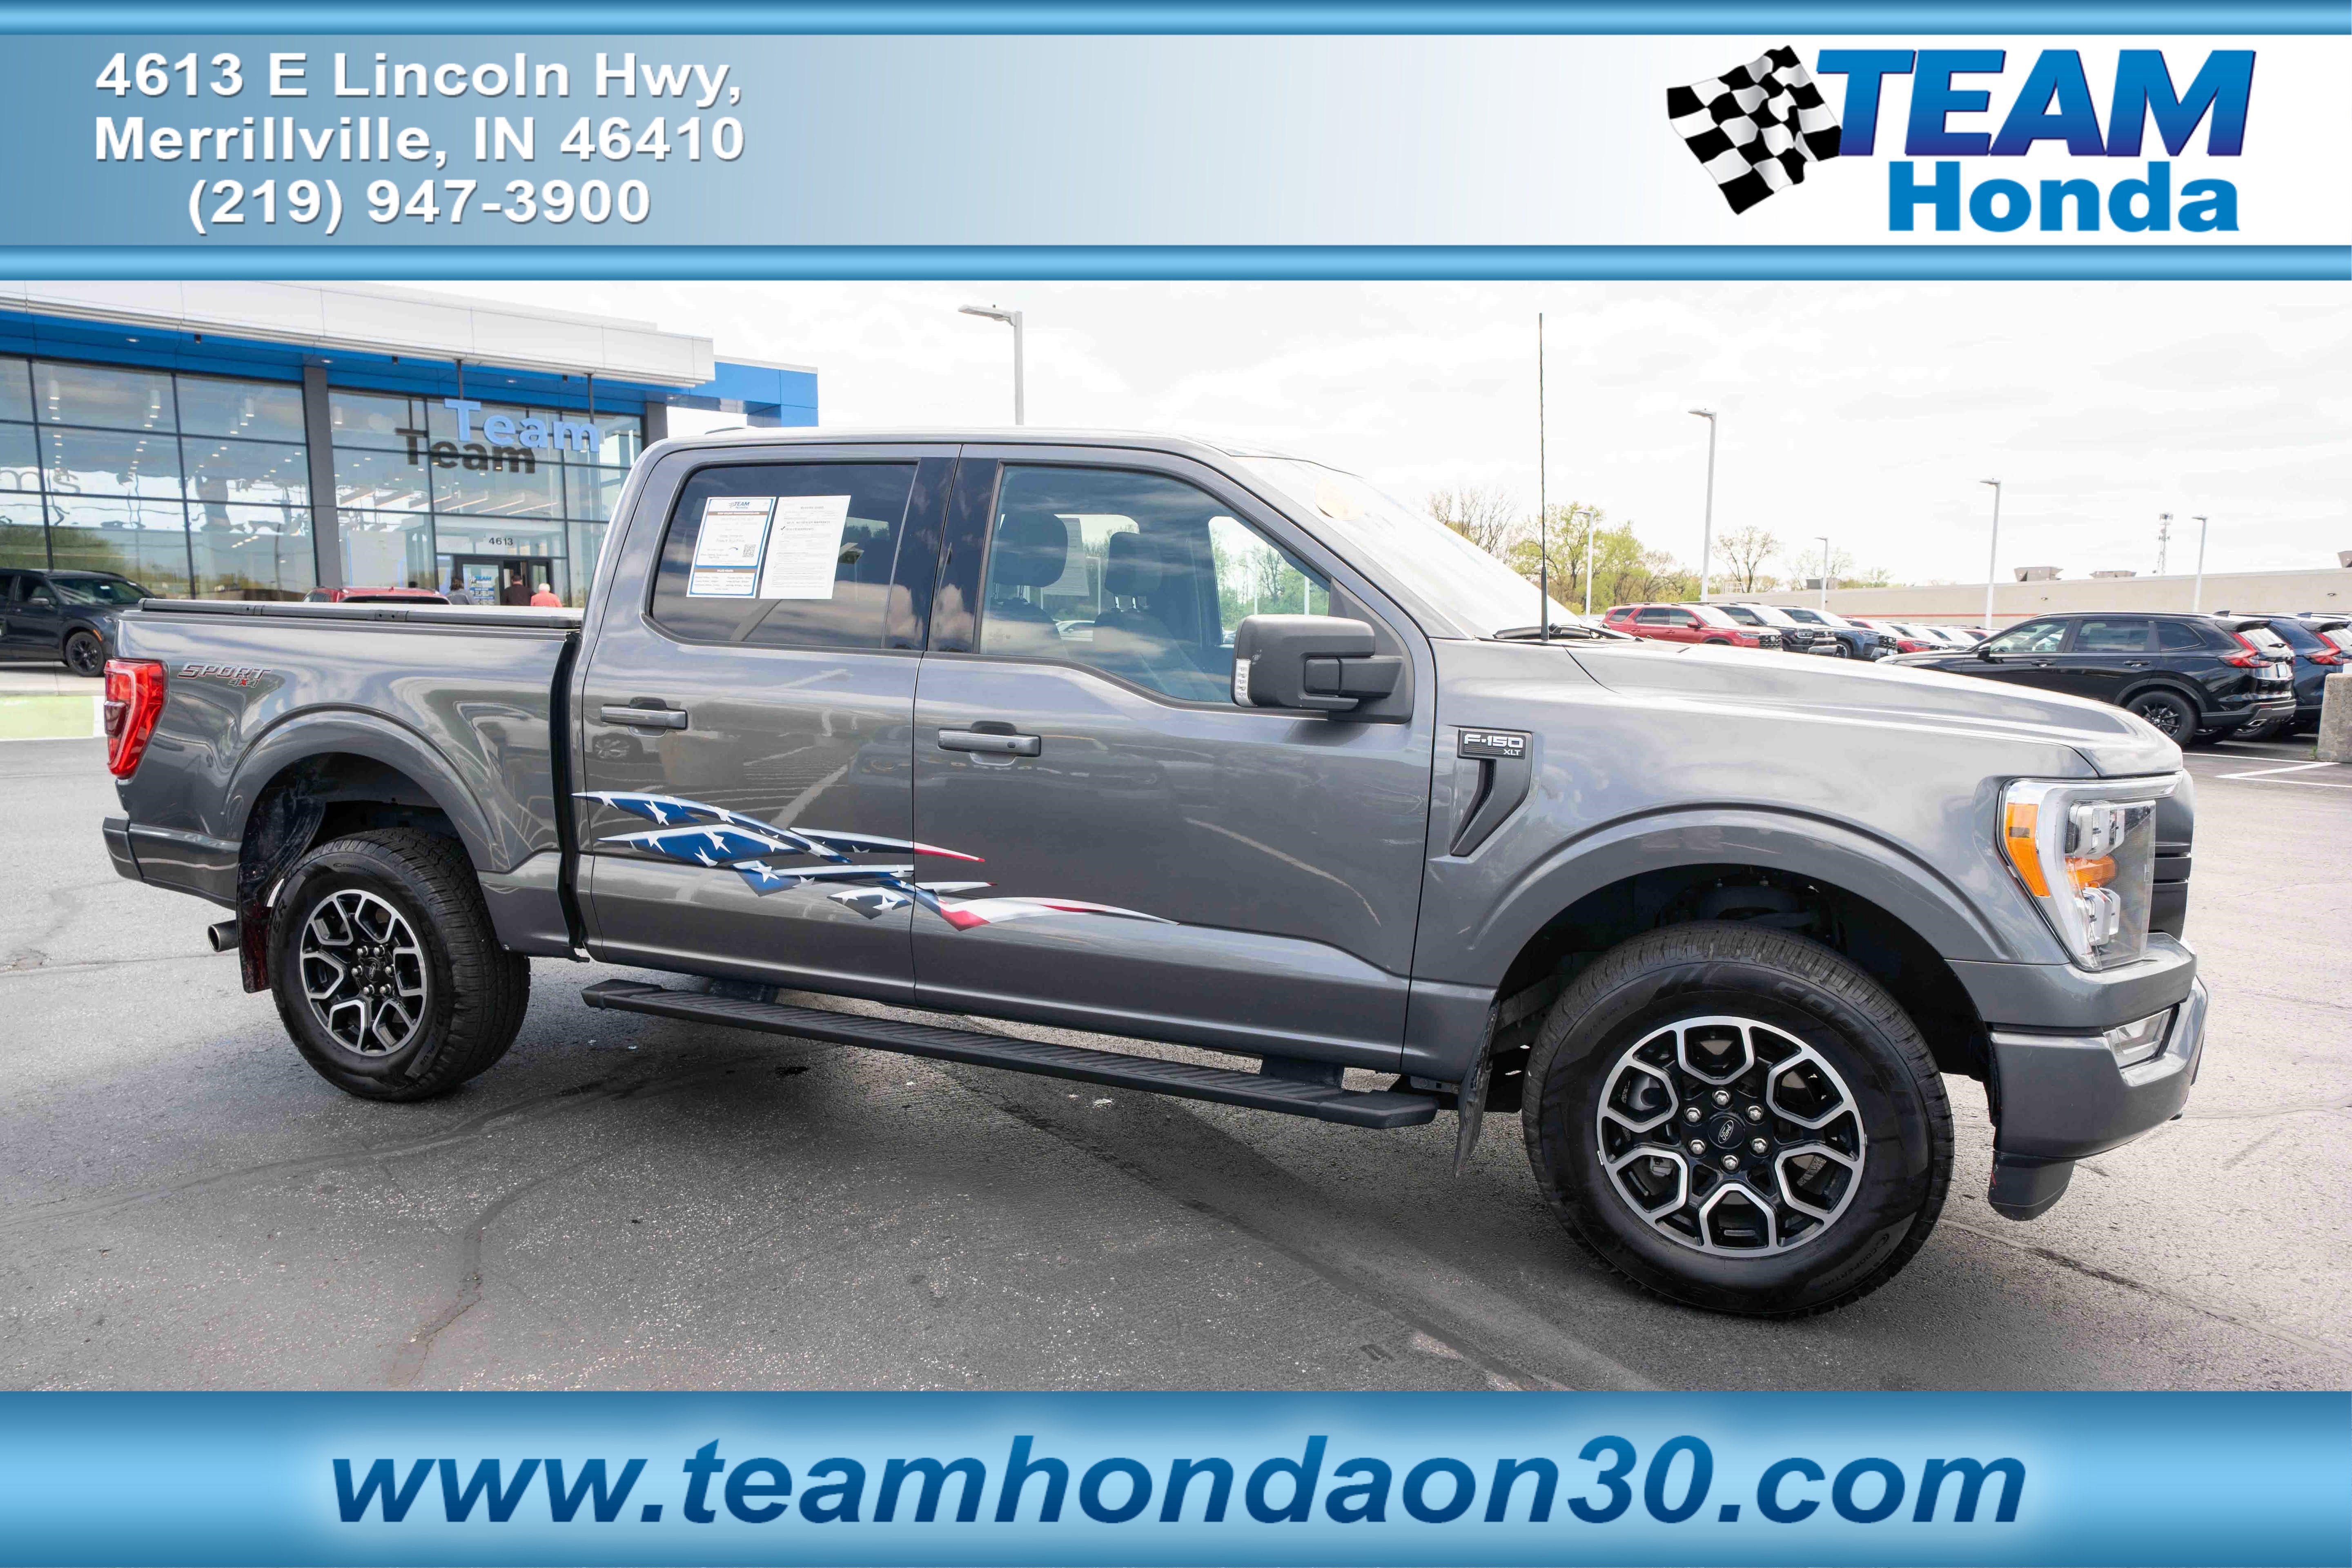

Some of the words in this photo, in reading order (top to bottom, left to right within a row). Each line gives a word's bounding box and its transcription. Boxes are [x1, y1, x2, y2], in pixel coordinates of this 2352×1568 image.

[444, 398, 599, 452] Team
[489, 537, 513, 546] 4613
[177, 662, 273, 679] SPORT
[1463, 733, 1524, 748] F-150
[1719, 1123, 1733, 1141] Ford
